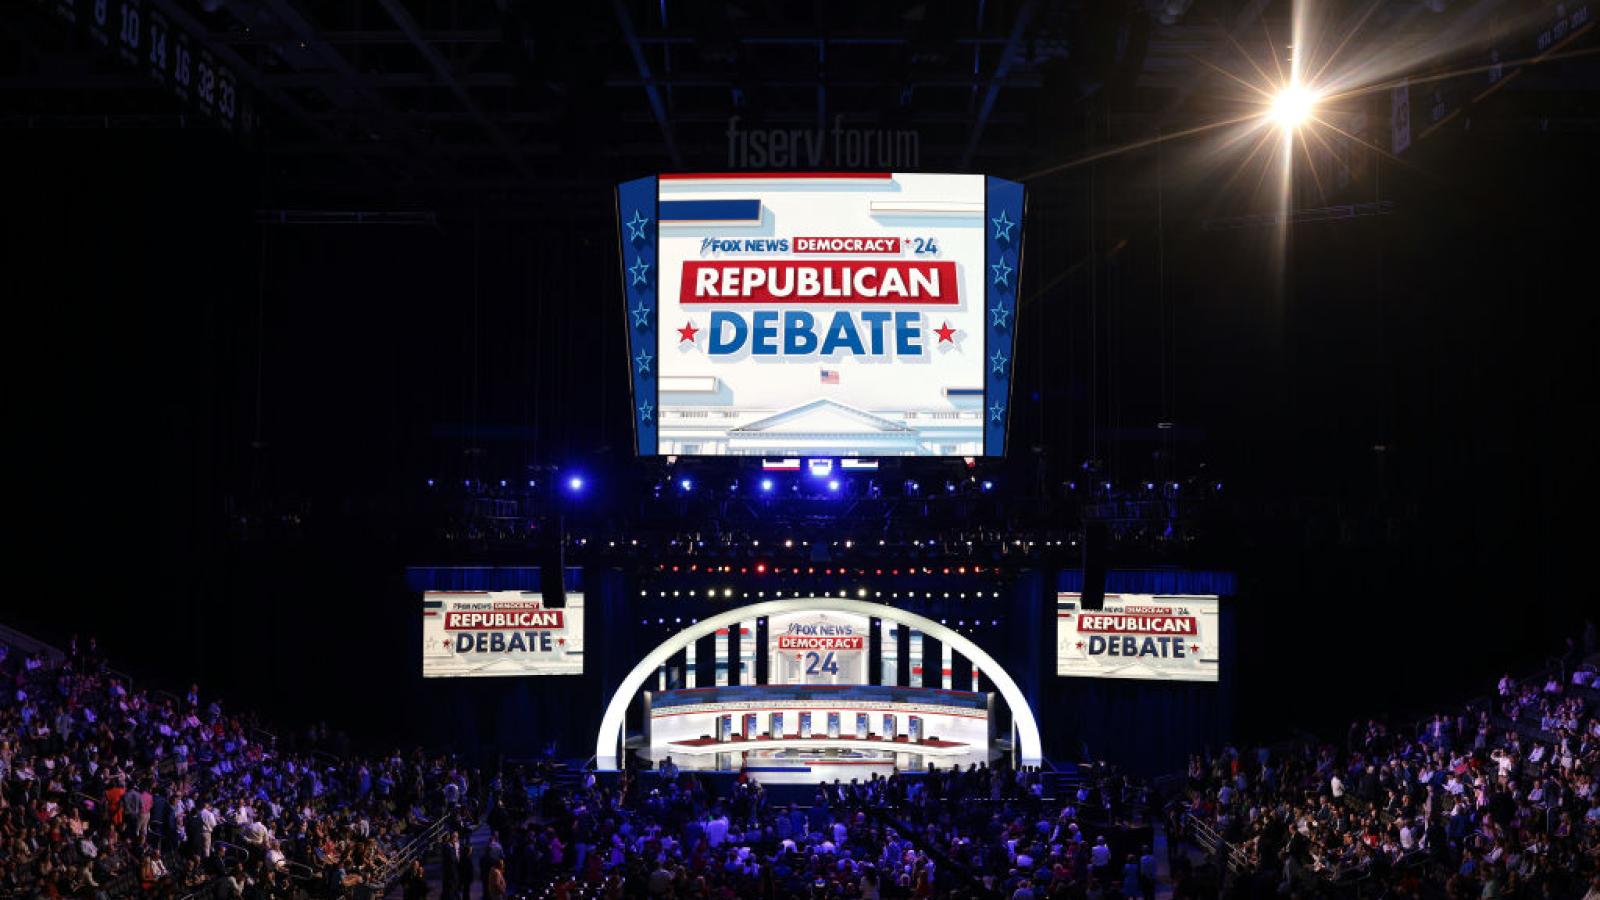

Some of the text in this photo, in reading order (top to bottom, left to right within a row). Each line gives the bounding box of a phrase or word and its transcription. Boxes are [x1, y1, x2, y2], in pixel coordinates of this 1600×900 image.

[121, 3, 140, 49] 10
[150, 25, 167, 69] 14
[199, 62, 215, 104] 32
[219, 79, 236, 119] 33
[725, 114, 920, 168] fiserv forum
[711, 239, 742, 252] FOX
[744, 239, 789, 252] NEWS
[797, 239, 896, 252] DEMOCRACY
[695, 266, 941, 298] REPUBLICAN
[708, 311, 923, 356] DEBATE
[449, 613, 558, 627] REPUBLICAN
[796, 624, 852, 635] FOX NEWS
[1082, 616, 1191, 632] REPUBLICAN
[455, 632, 552, 654] DEBATE
[782, 638, 859, 648] DEMOCRACY
[1088, 635, 1185, 658] DEBATE
[805, 651, 839, 675] 24
